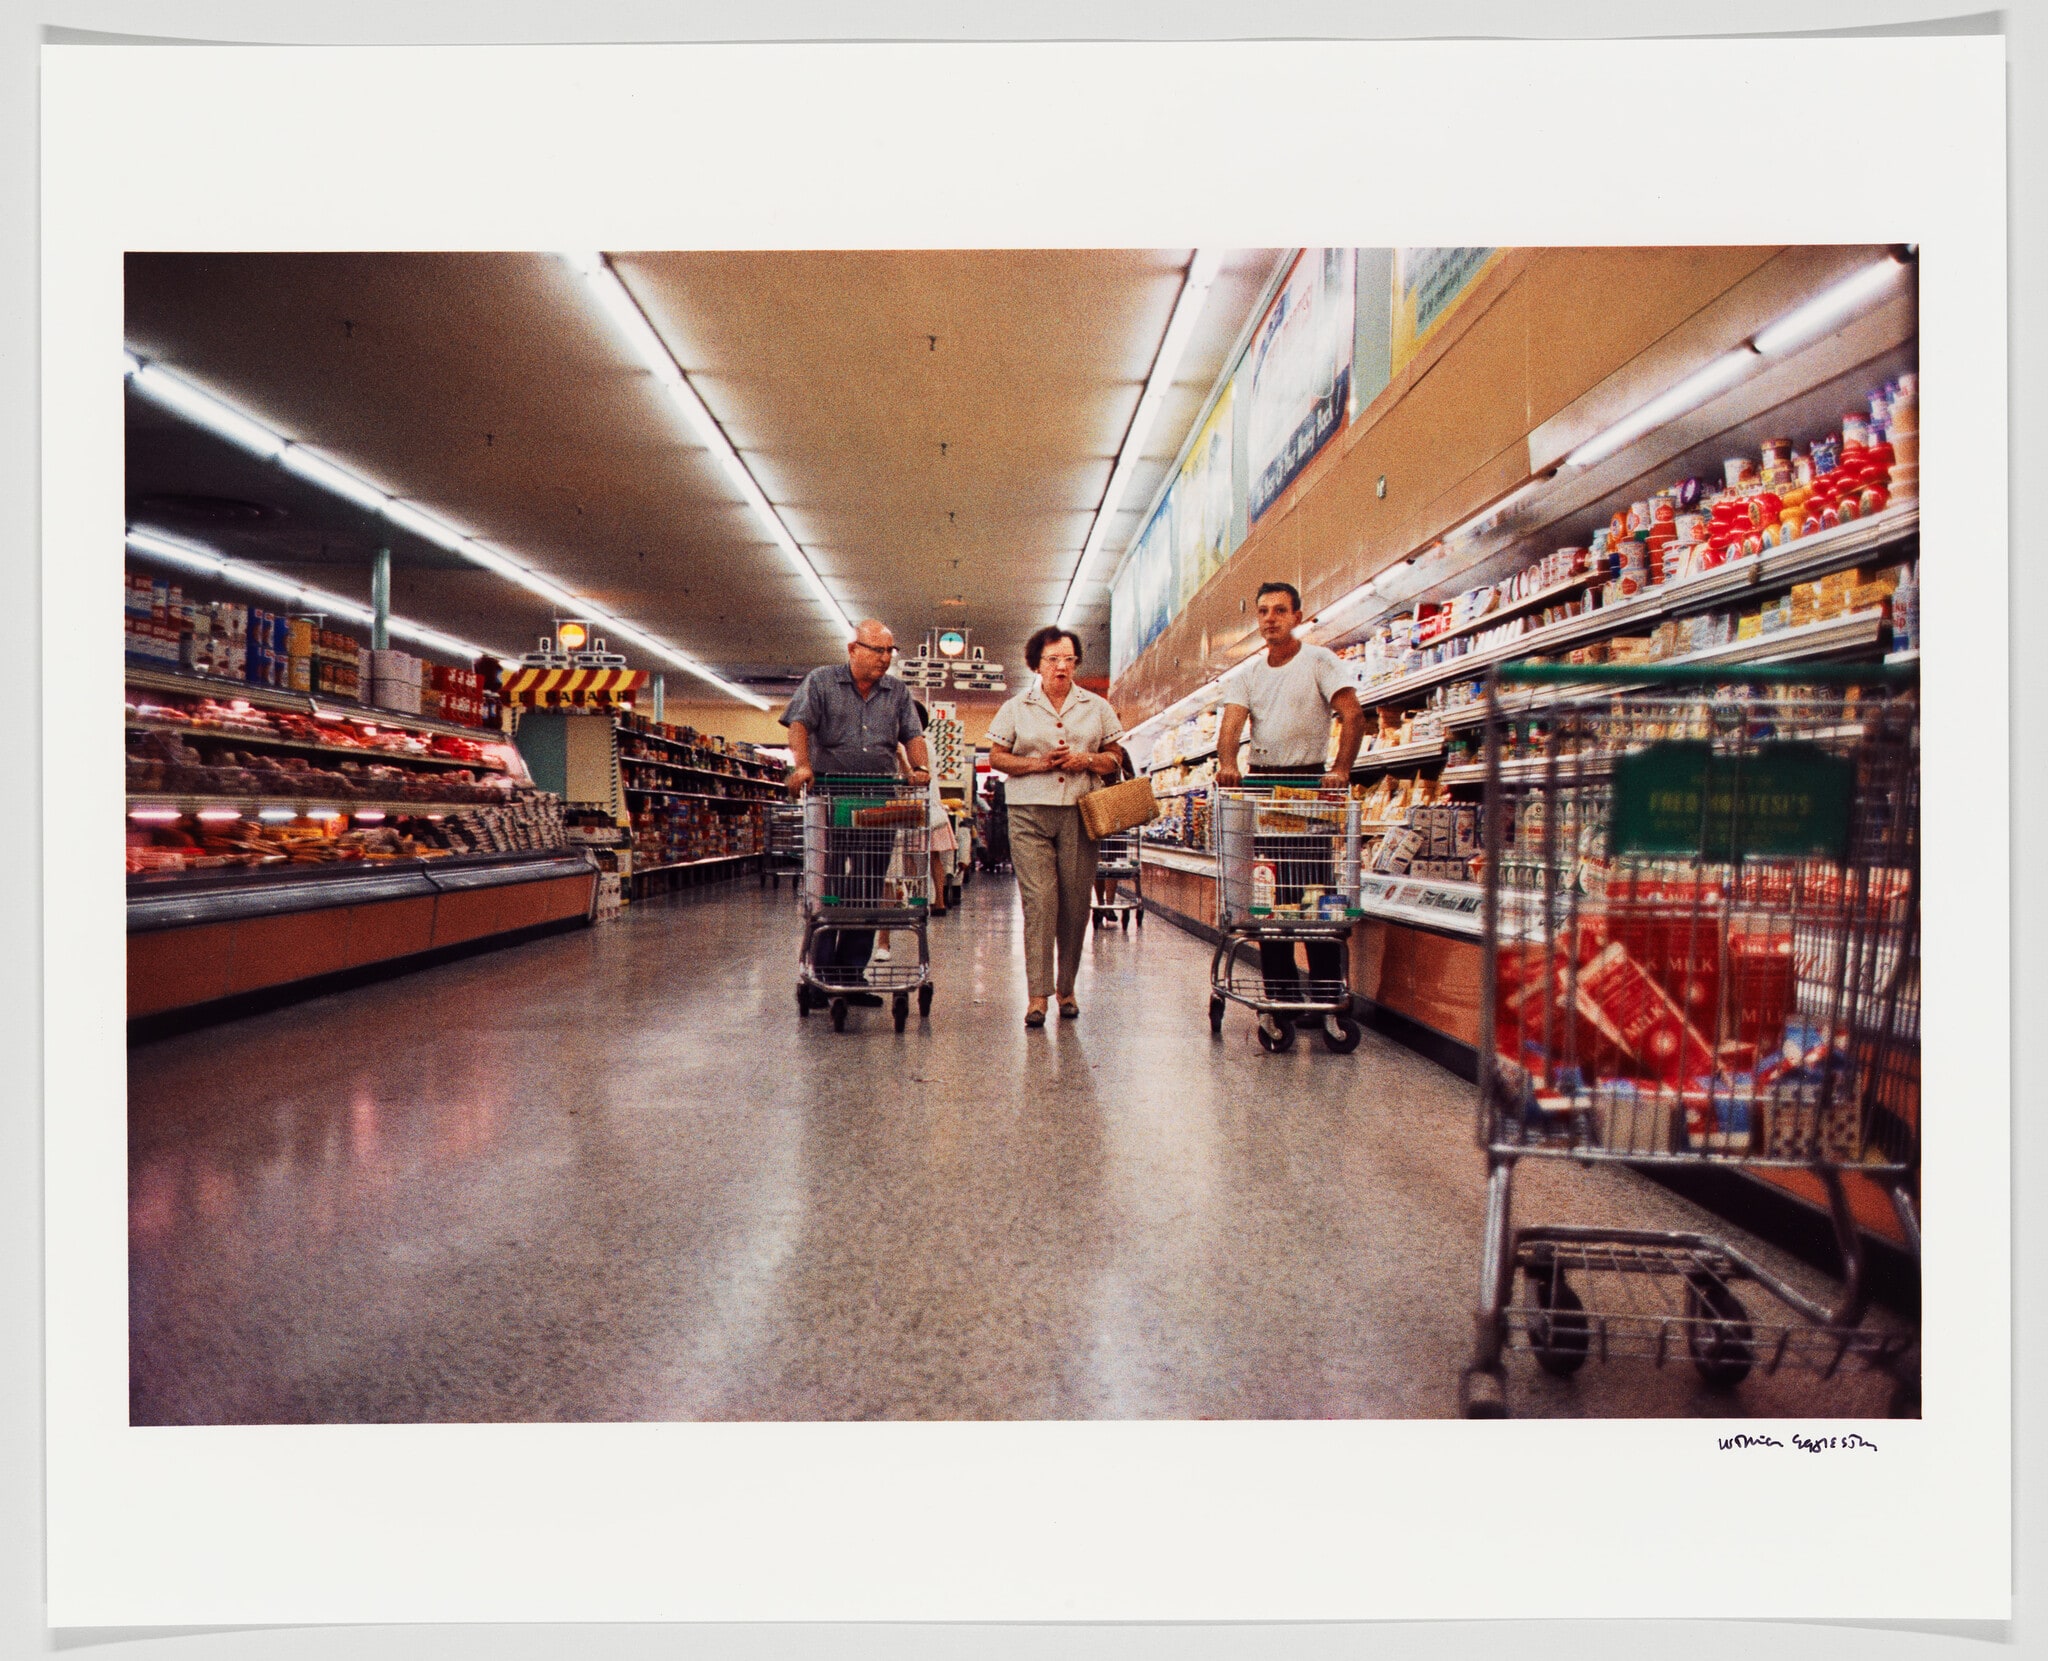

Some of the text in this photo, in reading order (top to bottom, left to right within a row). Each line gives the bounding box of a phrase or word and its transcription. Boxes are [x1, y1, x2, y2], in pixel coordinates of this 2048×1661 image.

[542, 639, 549, 650] B
[597, 640, 604, 651] A
[920, 645, 928, 657] B
[974, 648, 982, 659] A
[545, 691, 628, 703] BAZAAR
[1668, 957, 1713, 973] MILK
[1623, 1001, 1665, 1039] MILK
